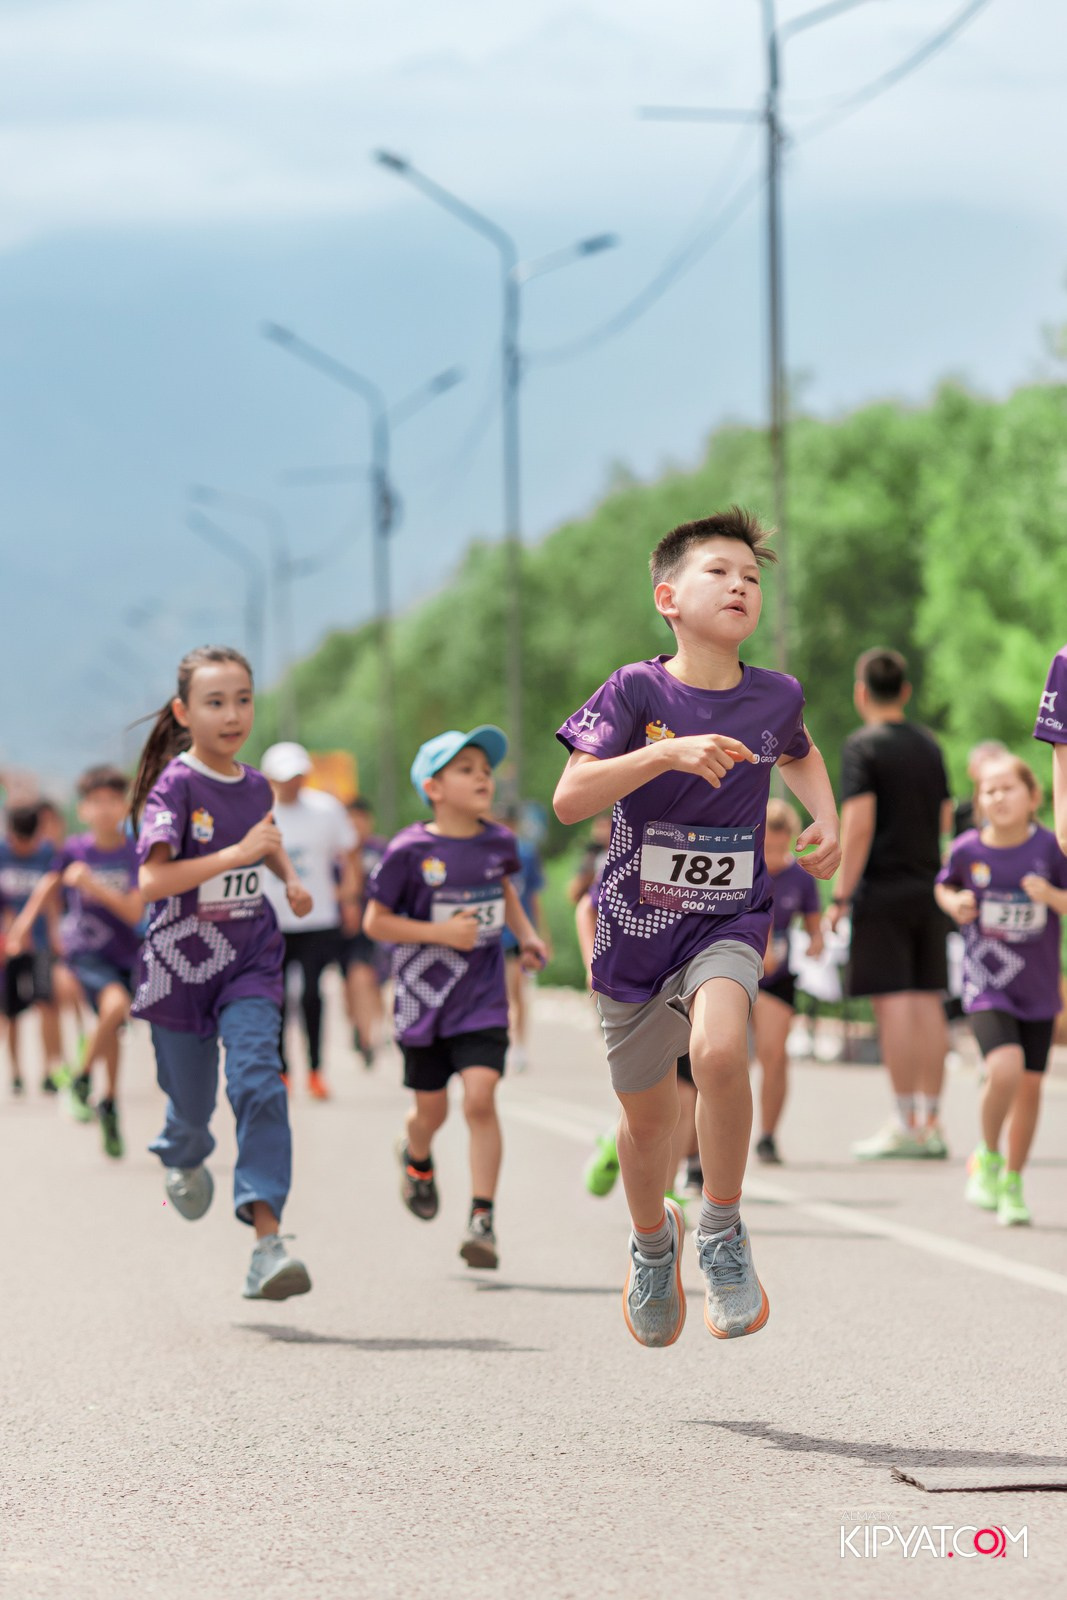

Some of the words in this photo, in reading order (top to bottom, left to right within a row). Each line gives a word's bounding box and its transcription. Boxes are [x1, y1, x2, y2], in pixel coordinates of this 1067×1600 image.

[1045, 717, 1064, 730] City
[655, 830, 674, 838] GROUP
[669, 854, 735, 886] 182
[223, 871, 259, 898] 110
[644, 883, 698, 899] БАЛАЛАР
[700, 891, 747, 901] ЖАРЫСЫ
[681, 900, 705, 911] 600
